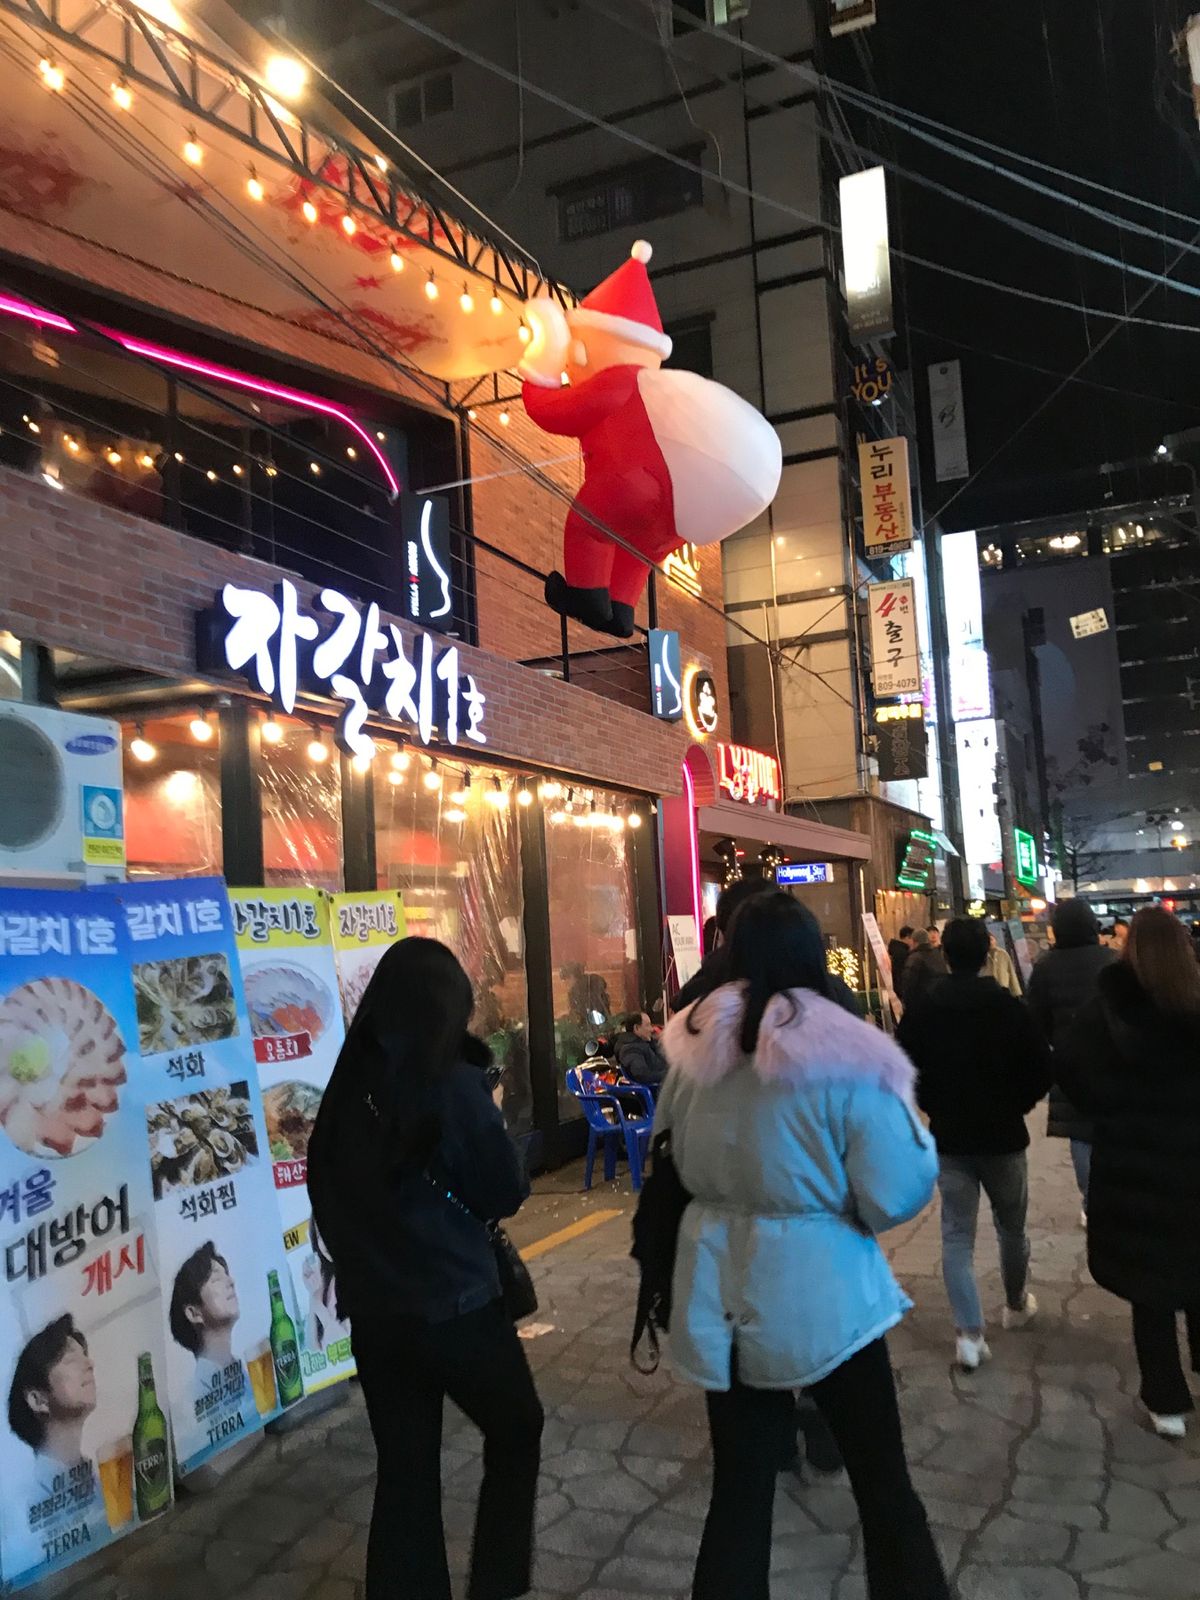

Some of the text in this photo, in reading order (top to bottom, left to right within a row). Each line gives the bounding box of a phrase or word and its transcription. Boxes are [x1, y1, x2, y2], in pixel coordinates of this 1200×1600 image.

[850, 371, 892, 401] YOU
[855, 357, 888, 382] Its
[870, 445, 900, 541] 누리 부동산
[884, 620, 904, 668] 출구
[222, 577, 488, 760] 자갈치1호
[877, 678, 917, 692] 809-4079
[338, 901, 399, 941] 자갈치1호
[165, 1051, 207, 1081] 석화
[277, 1163, 307, 1184] 해산
[0, 1168, 56, 1225] 겨울
[178, 1182, 238, 1223] 석화찜
[6, 1183, 130, 1278] 대방어
[81, 1234, 145, 1297] 개시
[206, 1411, 245, 1447] TERRA
[136, 1451, 165, 1473] TERRA
[42, 1523, 91, 1562] TERRA
